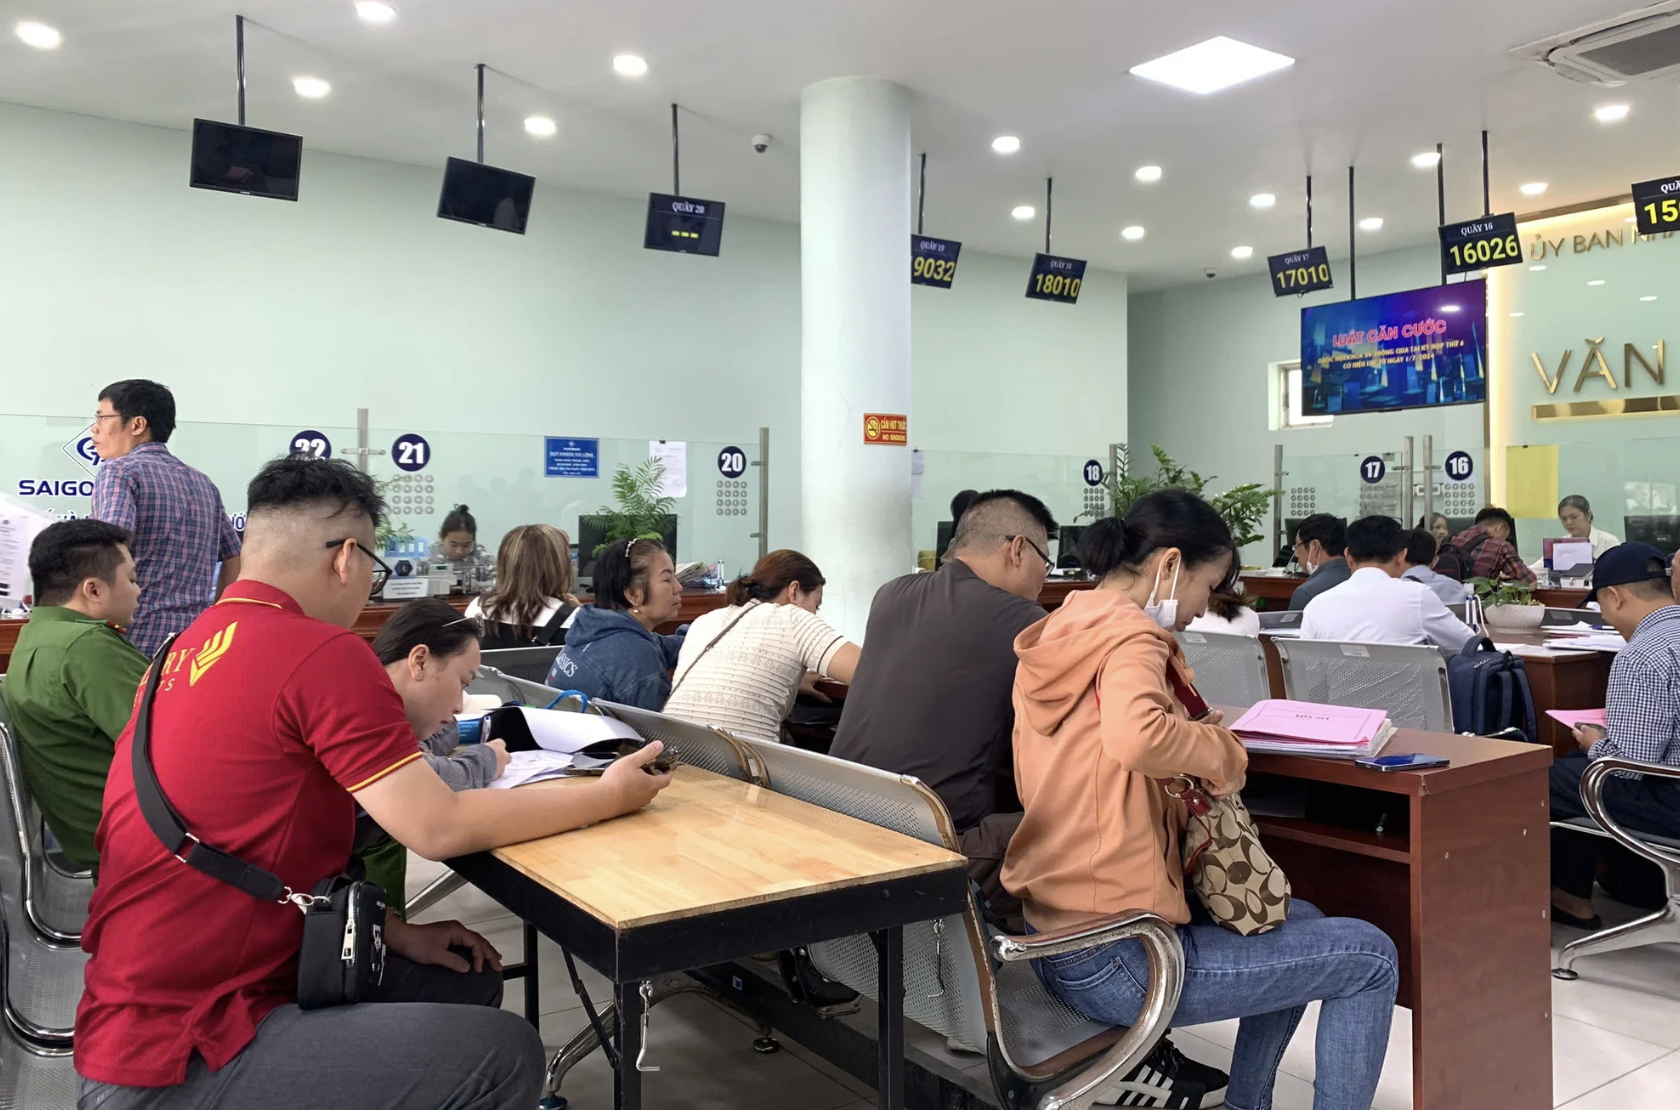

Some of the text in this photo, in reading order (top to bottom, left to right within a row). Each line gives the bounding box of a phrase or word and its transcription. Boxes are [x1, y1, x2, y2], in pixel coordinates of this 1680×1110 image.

[695, 206, 705, 214] 20
[1644, 199, 1680, 224] 15
[1484, 222, 1493, 231] 16
[1450, 235, 1518, 266] 16026
[1530, 234, 1565, 261] ỦY
[1573, 227, 1623, 254] BAN
[1302, 253, 1309, 261] 17
[1036, 273, 1080, 297] 18010
[1277, 264, 1329, 288] 17010
[1332, 317, 1446, 348] LUẬT CĂN CƯỚC
[1531, 337, 1665, 394] VĂN
[398, 442, 424, 465] 21
[721, 453, 743, 472] 20
[1086, 465, 1100, 481] 18
[1365, 461, 1381, 478] 17
[1449, 456, 1469, 475] 16
